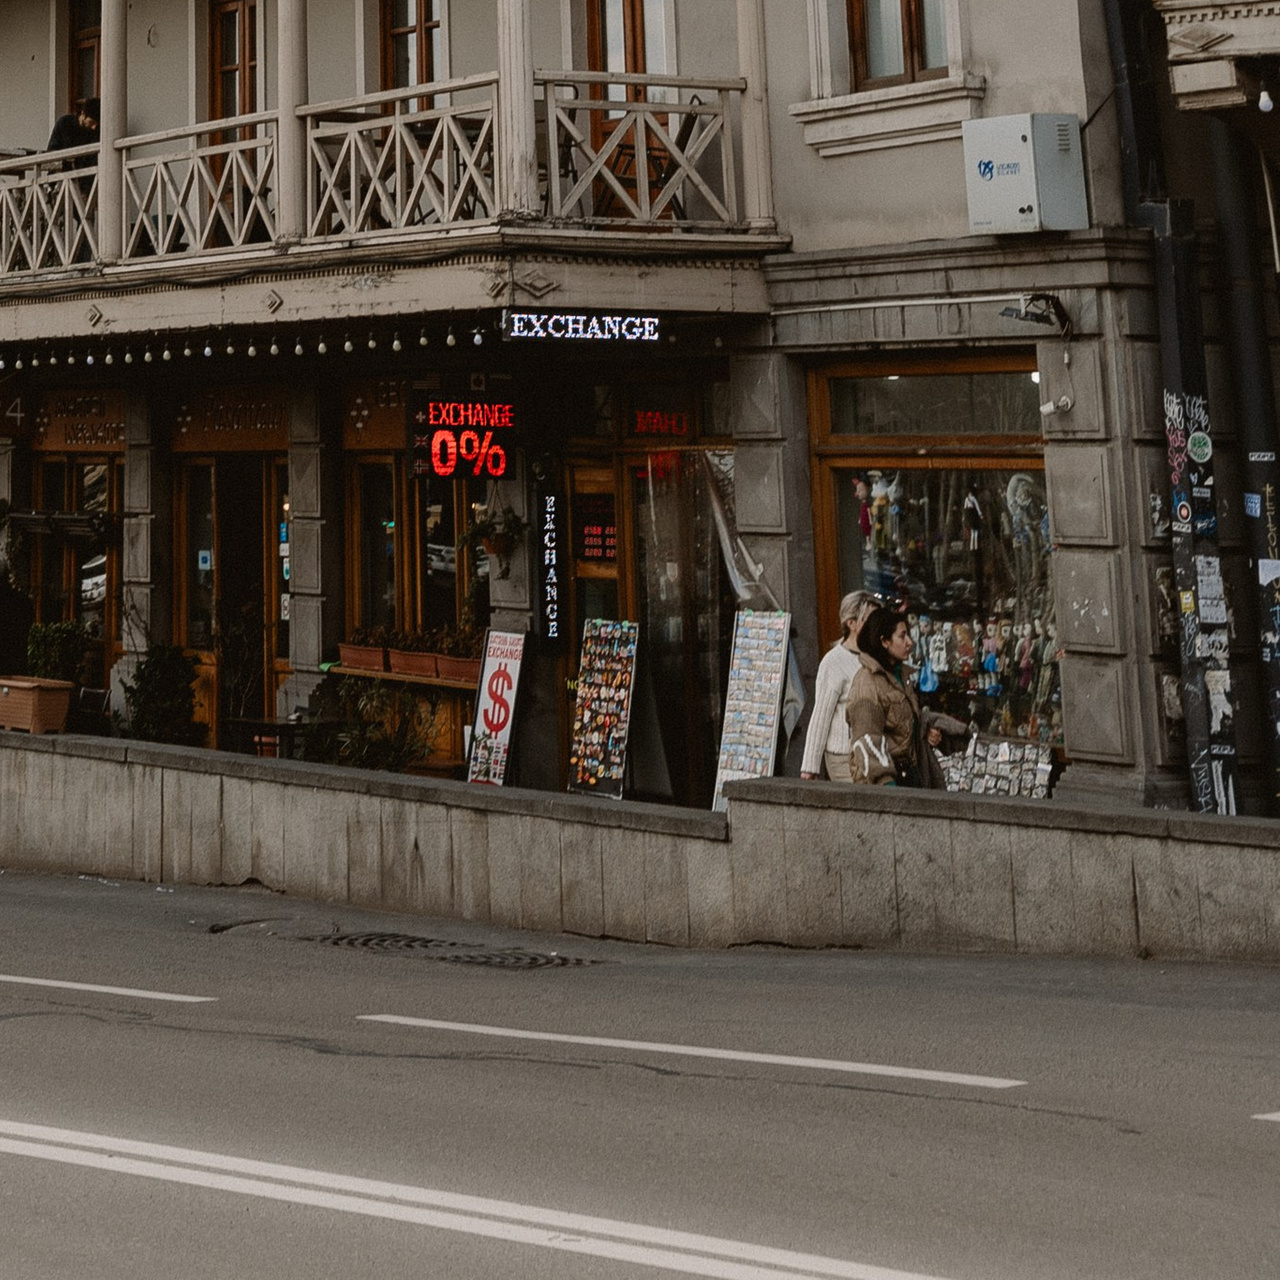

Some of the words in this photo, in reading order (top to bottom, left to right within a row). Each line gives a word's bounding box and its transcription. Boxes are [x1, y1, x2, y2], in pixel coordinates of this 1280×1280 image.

[510, 313, 659, 340] EXCHANGE
[429, 402, 515, 427] EXCHANGE
[431, 429, 507, 477] 0%
[544, 496, 559, 638] EXCHANGE
